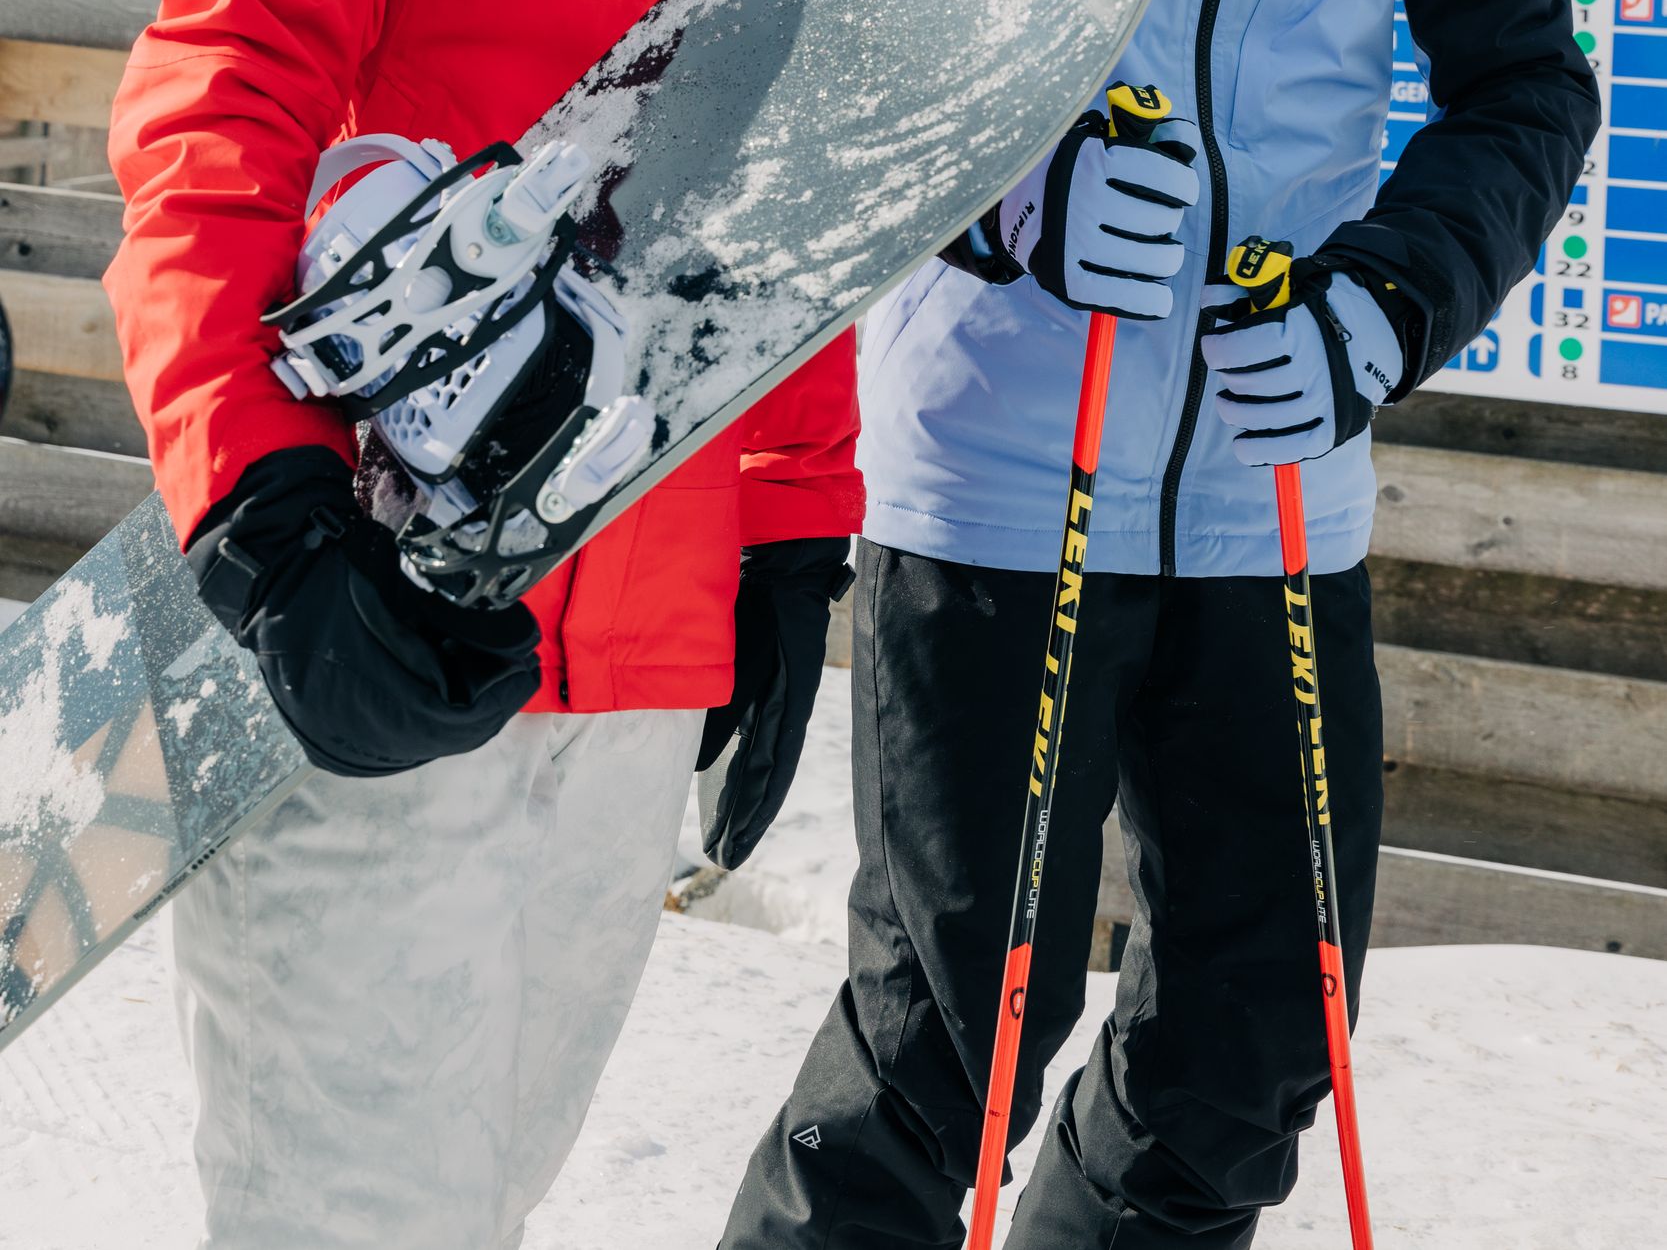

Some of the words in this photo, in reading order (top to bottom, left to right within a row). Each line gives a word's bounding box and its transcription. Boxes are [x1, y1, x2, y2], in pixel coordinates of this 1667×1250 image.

[1578, 9, 1588, 23] 1
[1568, 210, 1585, 226] 9
[1242, 240, 1271, 276] LEKI
[1556, 260, 1592, 279] 22
[1554, 311, 1590, 330] 32
[1561, 364, 1578, 380] 8
[1055, 488, 1094, 634] LEKI
[1284, 584, 1317, 705] LEKI
